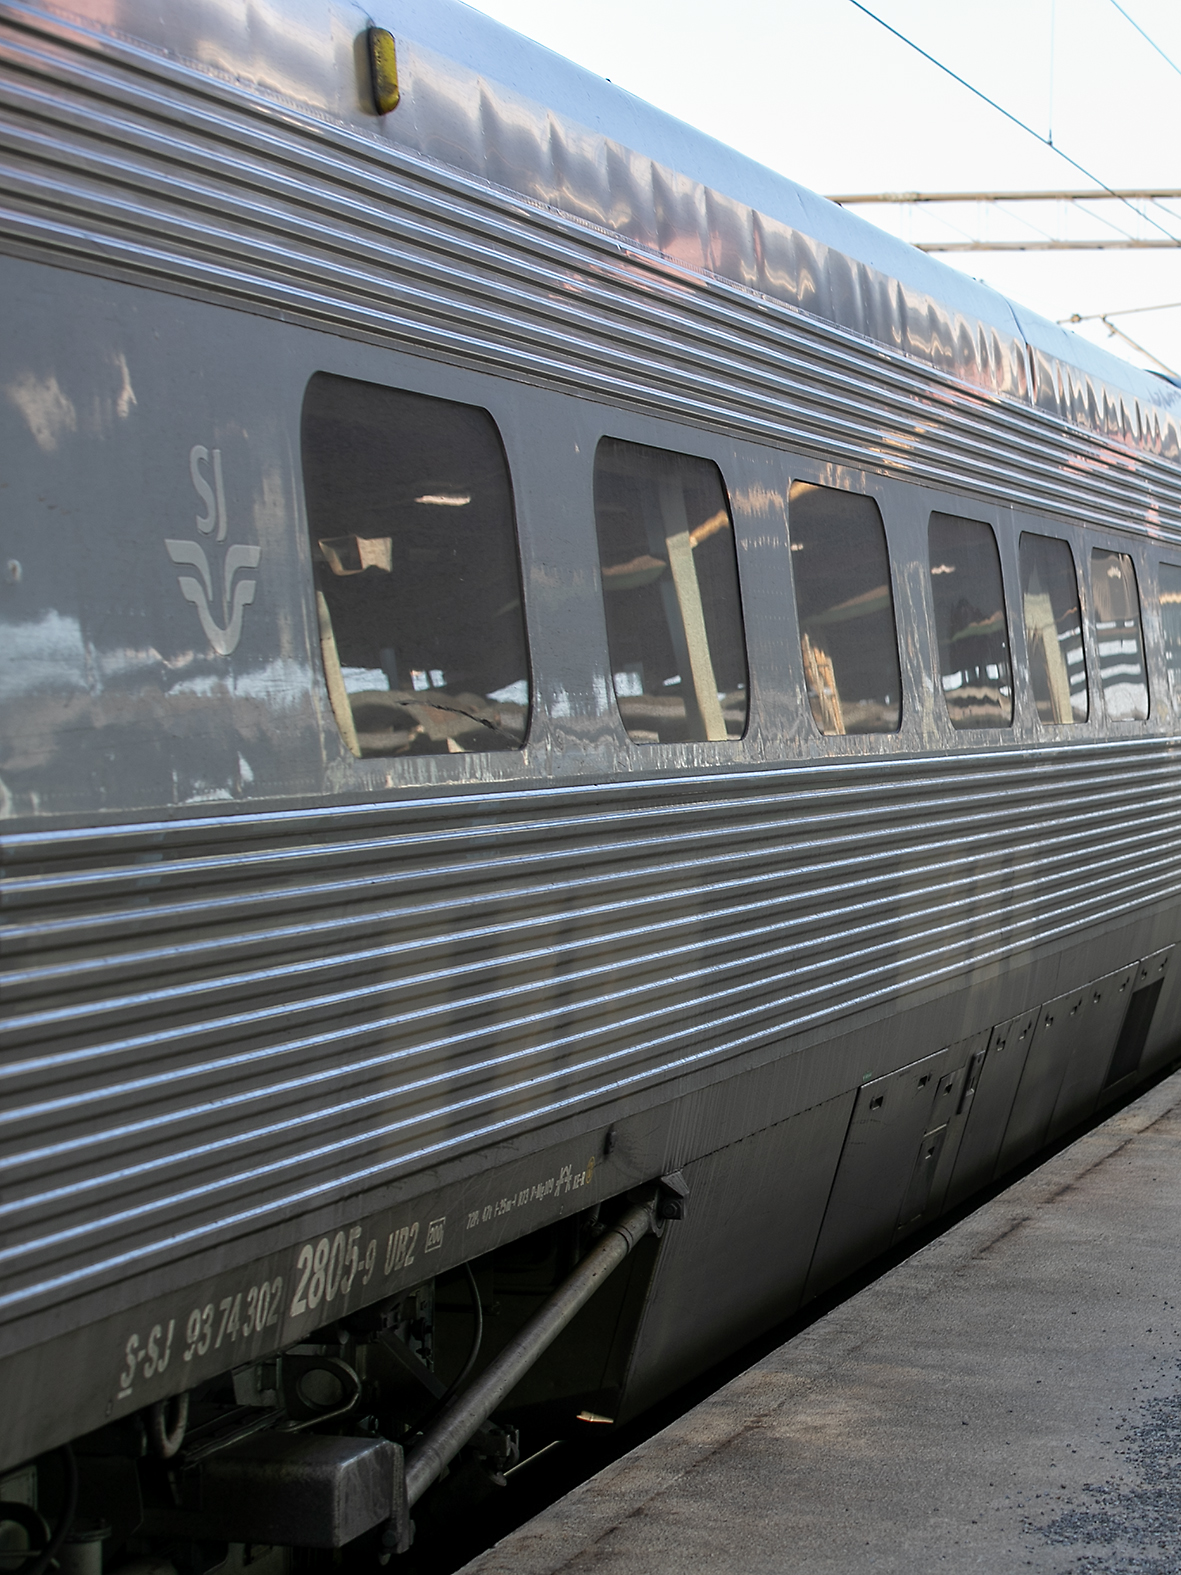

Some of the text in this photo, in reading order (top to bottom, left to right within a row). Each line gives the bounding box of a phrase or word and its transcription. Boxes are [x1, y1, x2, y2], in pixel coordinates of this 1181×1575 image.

[190, 445, 228, 542] SJ
[119, 1319, 175, 1394] S-SJ
[384, 1222, 420, 1275] UB2
